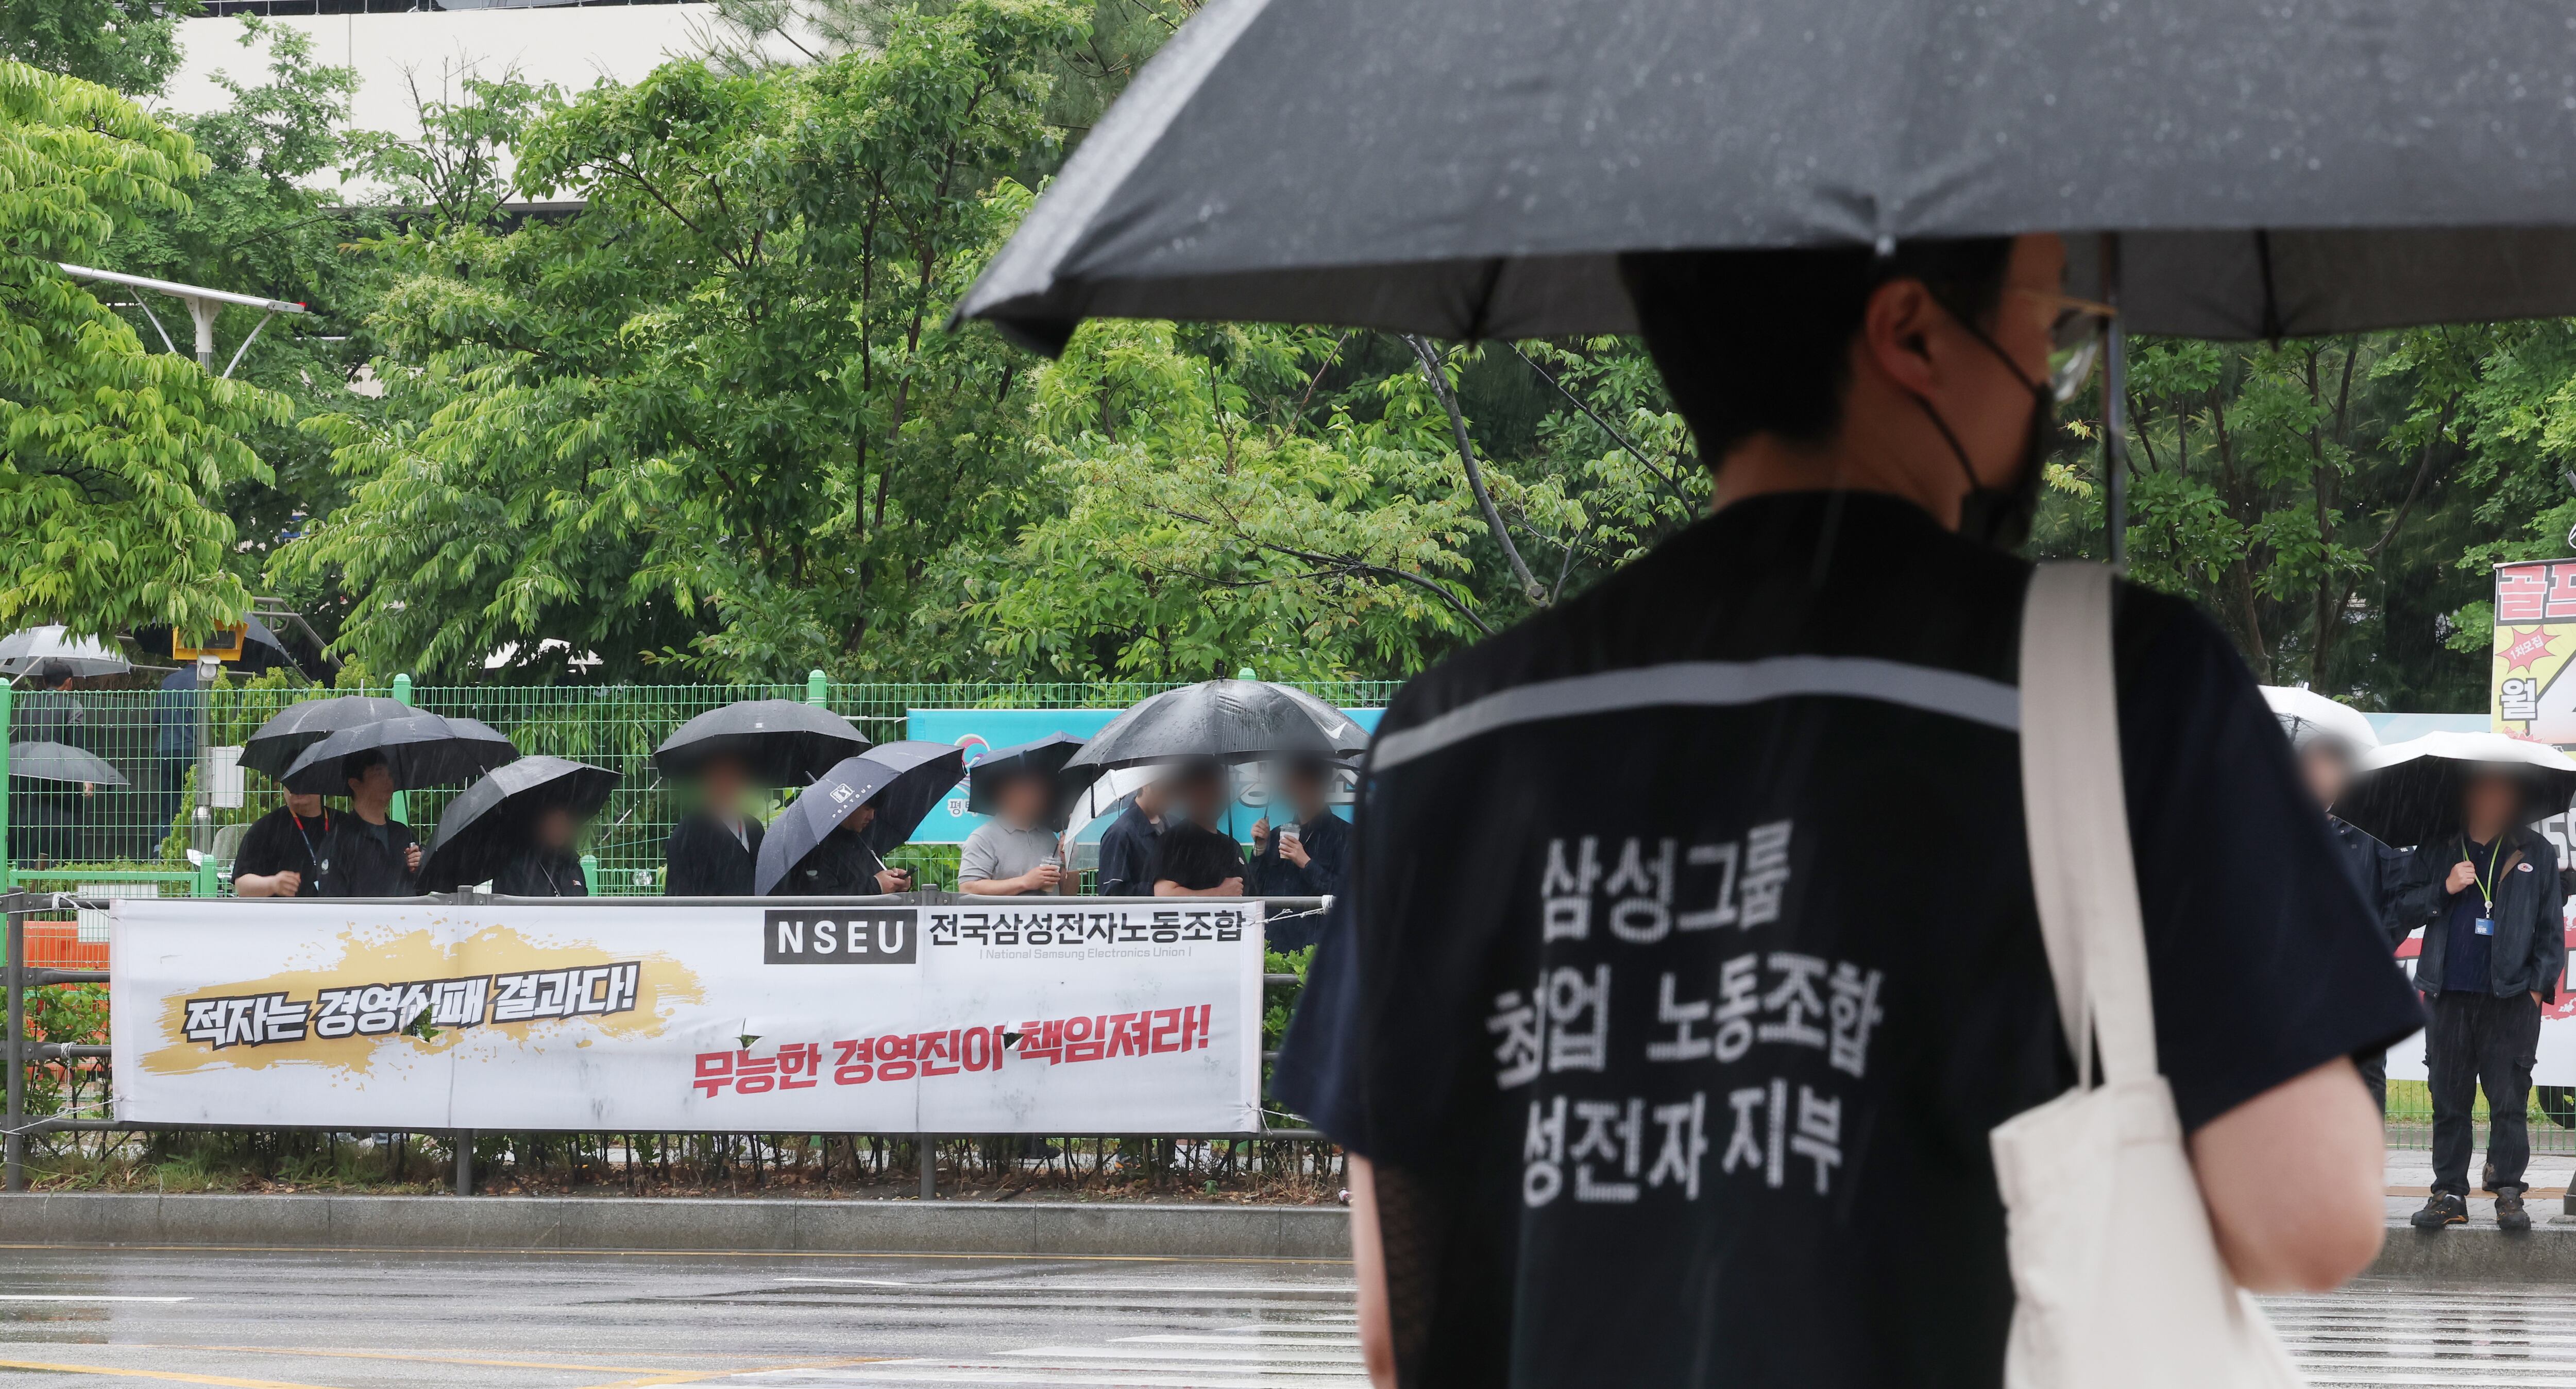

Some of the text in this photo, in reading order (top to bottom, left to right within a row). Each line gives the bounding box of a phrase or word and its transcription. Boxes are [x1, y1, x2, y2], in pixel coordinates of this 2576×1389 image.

[2510, 635, 2544, 660] 1차모집
[2500, 678, 2537, 721] 월
[1542, 821, 1791, 944] 삼성그룹
[778, 920, 904, 954] NSEU
[929, 910, 1246, 946] 전국삼성전자노동조합
[986, 947, 1185, 961] National Samsung Electronics Union
[184, 994, 308, 1047] 적자는
[493, 964, 638, 1021] 결과다!
[1648, 953, 1880, 1076] 노동조합
[693, 1004, 1211, 1099] 무능한 경영진이 책임져라!
[1723, 1079, 1841, 1193] 지부
